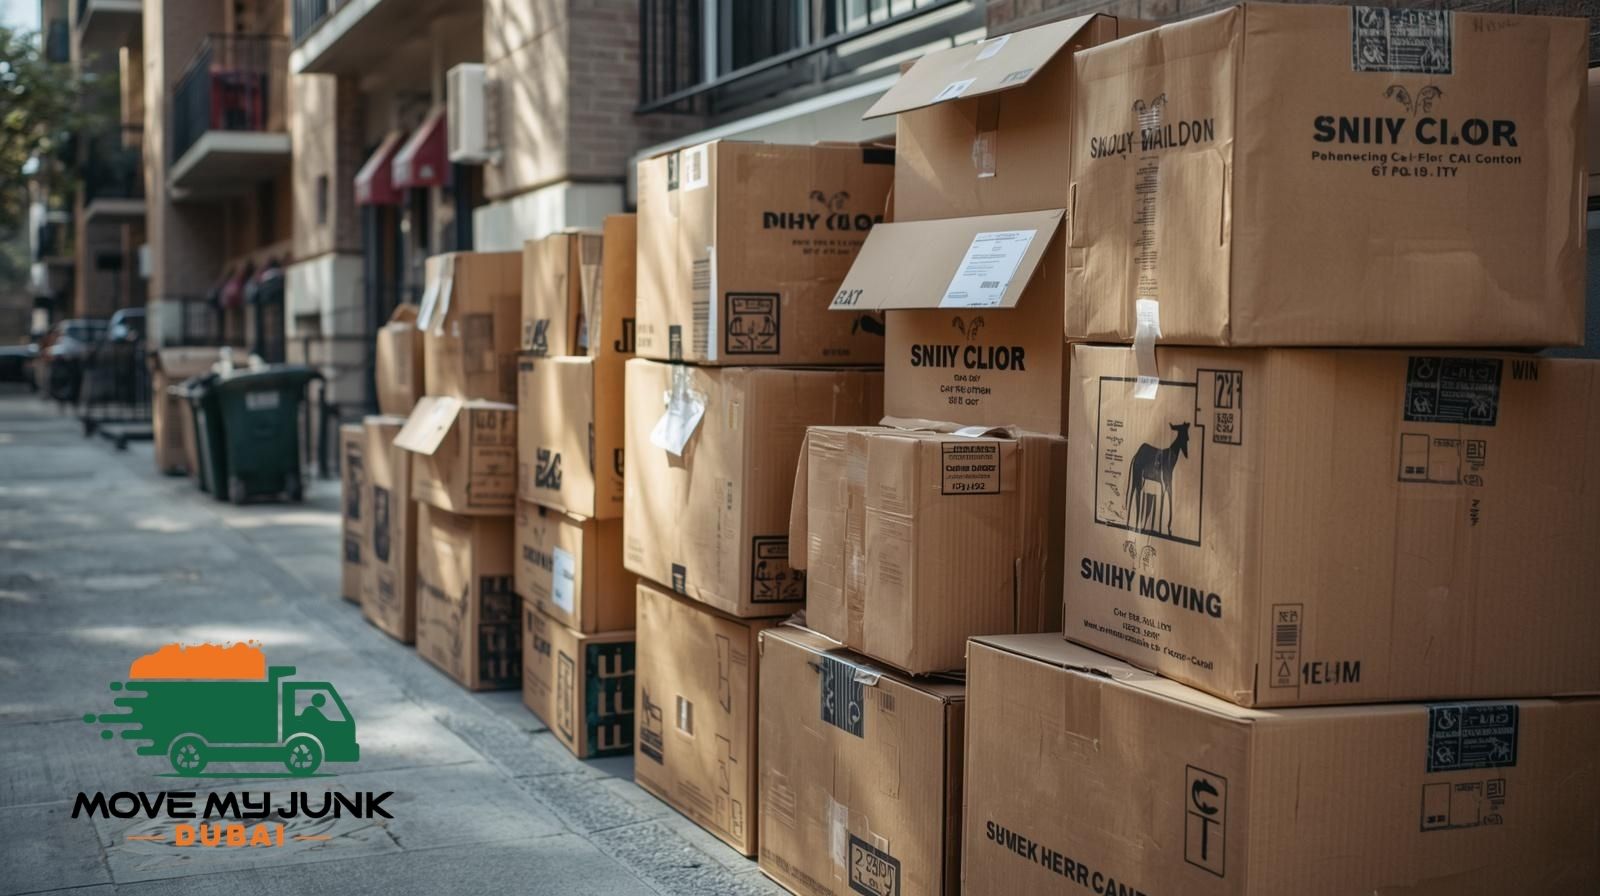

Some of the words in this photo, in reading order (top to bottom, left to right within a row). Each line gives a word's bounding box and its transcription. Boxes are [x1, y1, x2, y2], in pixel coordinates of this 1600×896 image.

[1511, 359, 1538, 381] WIN
[1139, 575, 1222, 618] MOVING
[1041, 846, 1089, 888] HERR
